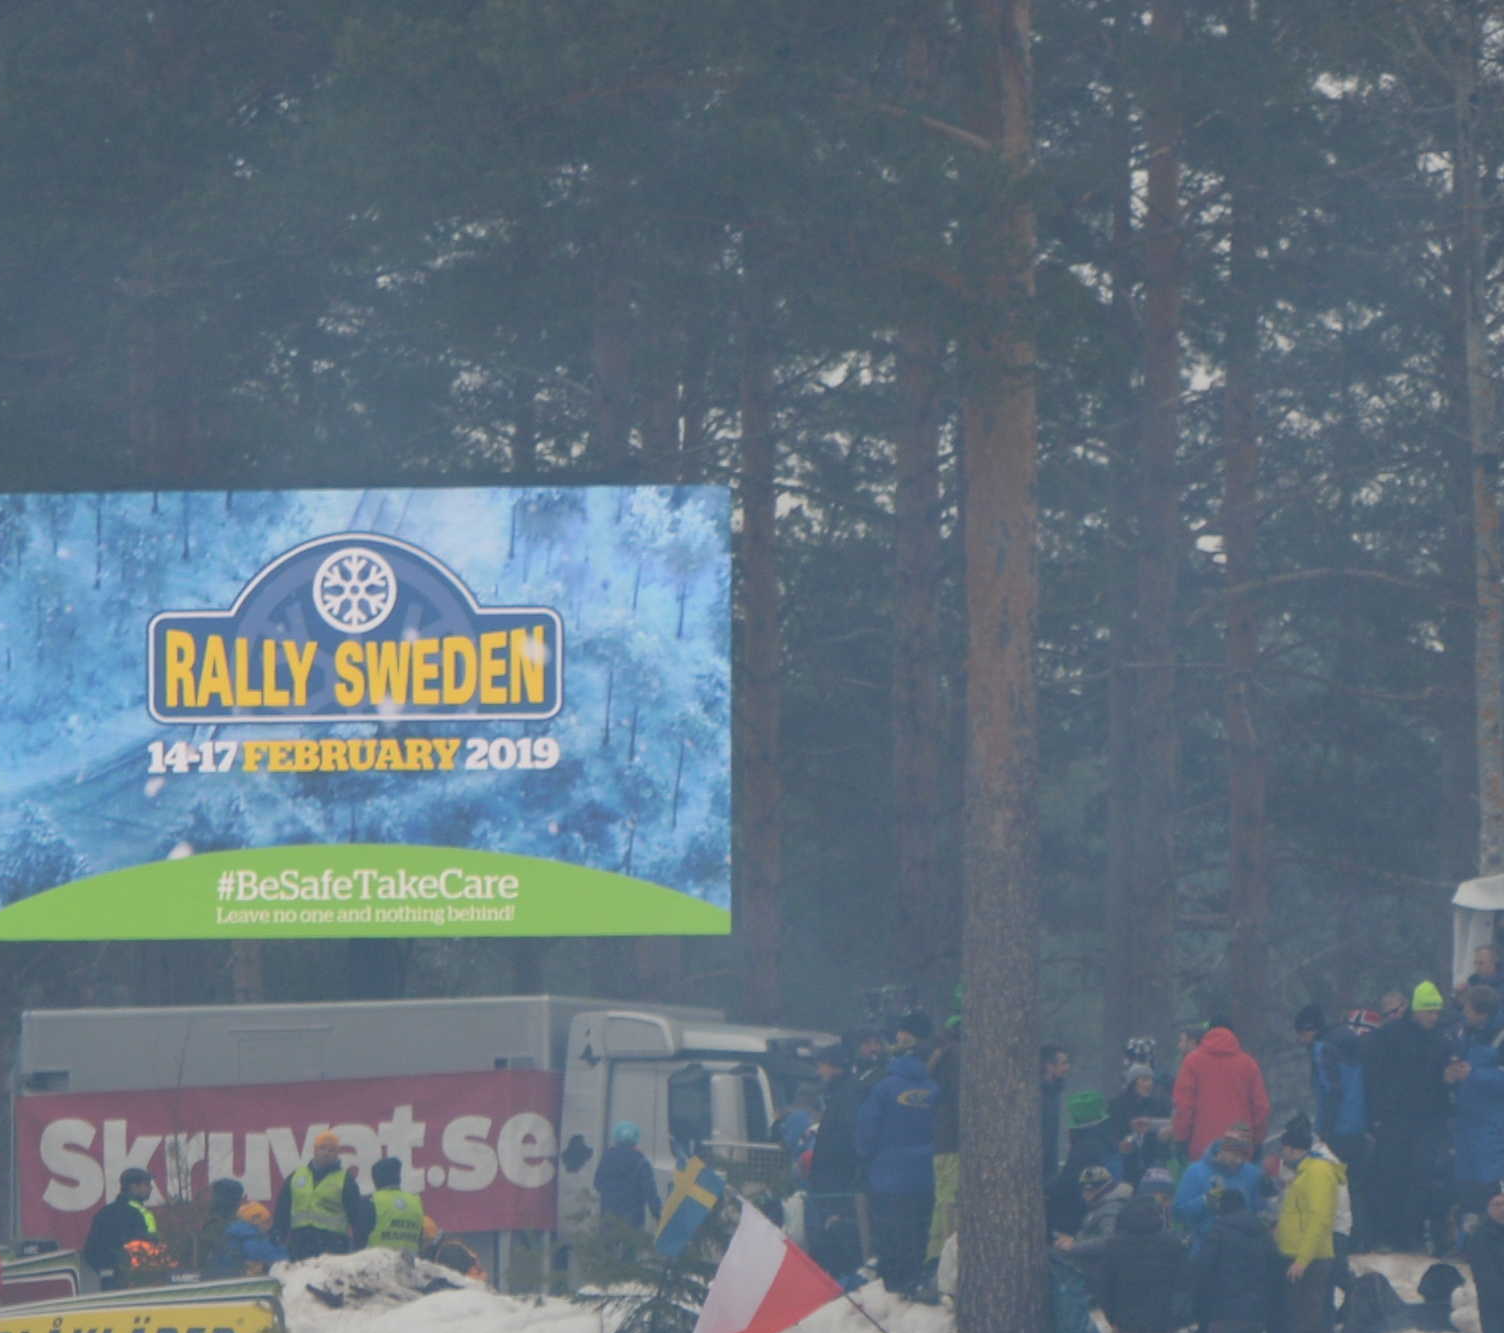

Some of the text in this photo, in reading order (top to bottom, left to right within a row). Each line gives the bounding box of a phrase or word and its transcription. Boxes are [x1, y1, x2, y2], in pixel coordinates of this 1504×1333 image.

[165, 625, 546, 708] RALLY SWEDEN
[147, 736, 560, 774] 14-17 FEBRUARY 2019
[216, 868, 520, 901] #BeSafeTakeCare
[216, 904, 516, 926] Leave no one and nothing behind!
